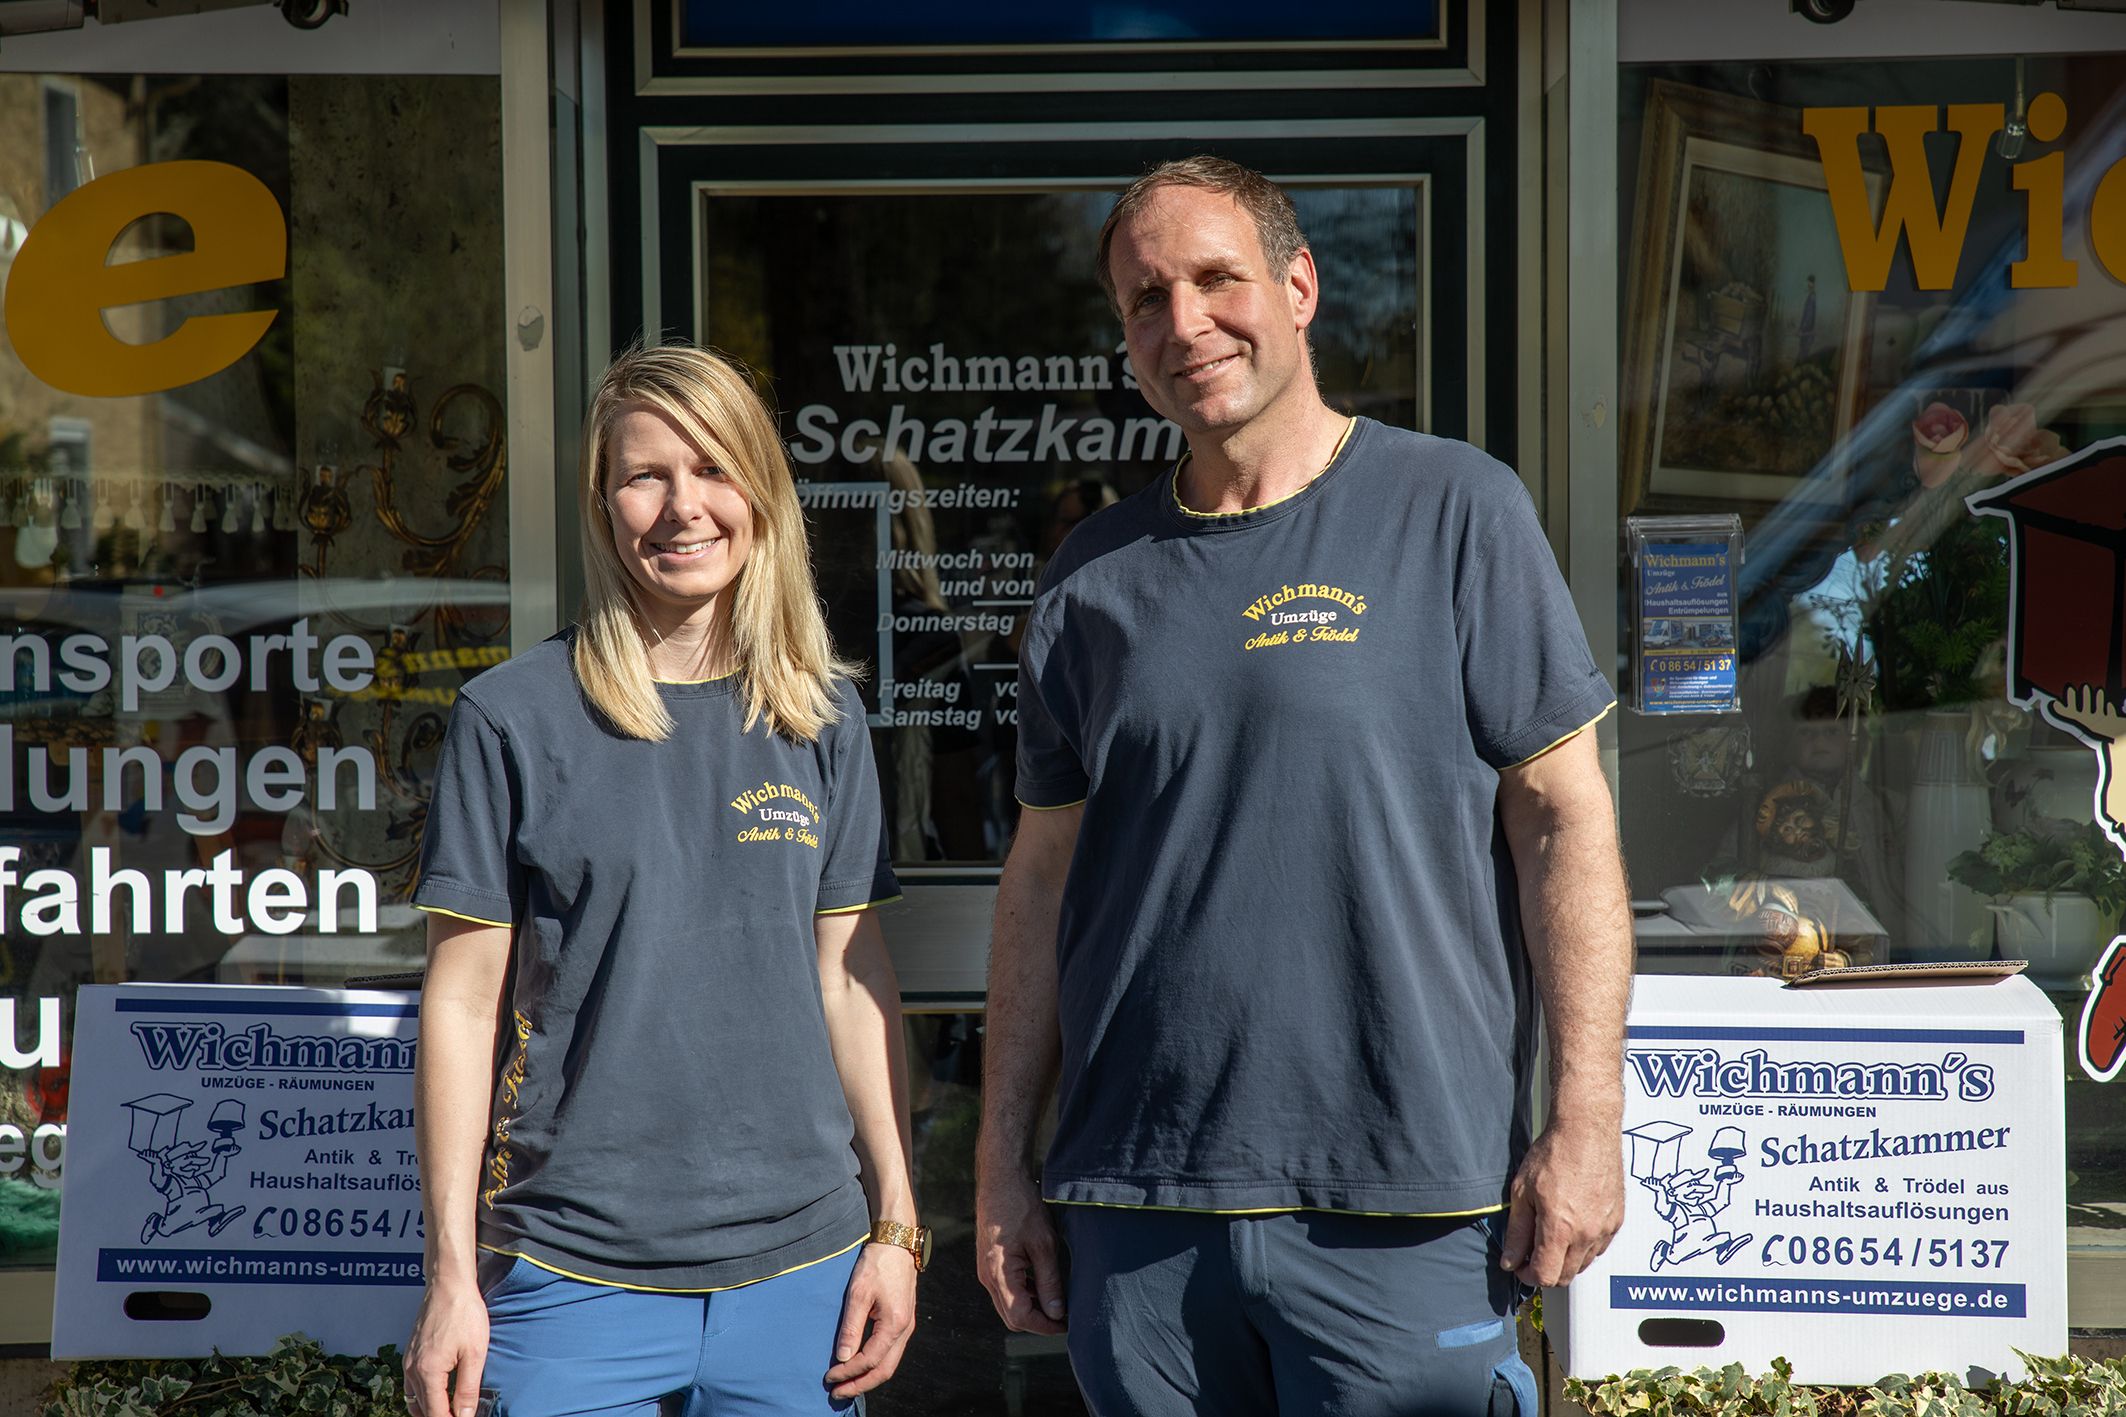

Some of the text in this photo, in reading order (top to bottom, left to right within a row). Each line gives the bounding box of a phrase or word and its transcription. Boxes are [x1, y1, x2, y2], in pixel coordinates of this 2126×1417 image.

[4, 160, 288, 398] e
[876, 549, 1035, 571] Mittwoch von
[1644, 553, 1726, 567] Wichmann's
[939, 577, 1035, 597] und von
[1241, 583, 1367, 622] Wichmann's
[1645, 598, 1728, 607] Haushaltsauflösungen
[1668, 607, 1729, 615] Entrümpelungen
[877, 612, 1015, 636] Donnerstag
[1271, 610, 1337, 626] Umzüge
[1245, 626, 1360, 650] Antik & Trödel
[0, 617, 375, 712] nsporte
[1704, 659, 1716, 671] 51
[1718, 659, 1732, 671] 37
[878, 678, 961, 702] Freitag
[879, 706, 982, 730] Samstag
[0, 724, 377, 836] lungen
[759, 808, 810, 826] Umzüge
[737, 826, 781, 843] Antik
[784, 827, 794, 840] &
[201, 1075, 265, 1090] UMZÜGE
[278, 1076, 375, 1092] RÄUMUNGEN
[1626, 1048, 1995, 1102] Wichmann's
[259, 1102, 416, 1141] Schatzka
[1699, 1103, 1764, 1117] UMZÜGE
[1777, 1103, 1877, 1118] RÄUMUNGEN
[304, 1149, 419, 1166] Antik & Tr
[1760, 1126, 2010, 1168] Schatzkammer
[1809, 1176, 2009, 1196] Antik & Trödel aus
[1754, 1199, 2010, 1224] Haushaltsauflösungen
[116, 1254, 427, 1280] www.wichmanns-umzue
[1628, 1283, 2009, 1311] www.wichmanns-umzuege.de
